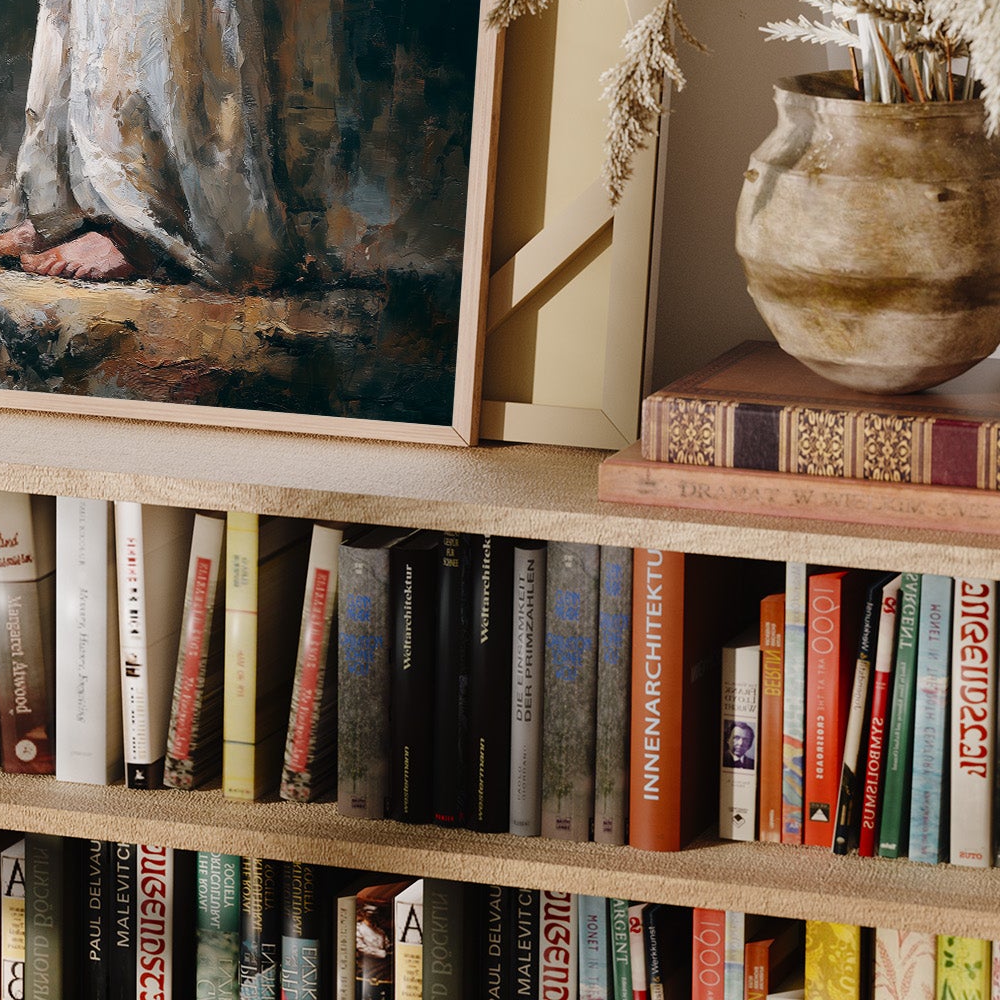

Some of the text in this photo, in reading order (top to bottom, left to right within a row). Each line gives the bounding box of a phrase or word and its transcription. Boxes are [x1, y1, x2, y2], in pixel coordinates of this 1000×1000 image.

[6, 595, 32, 714] Margaret Atwood
[402, 564, 413, 670] Weltarchitektur
[516, 575, 526, 722] DIE EINSAMKEIT
[524, 559, 536, 722] DER PRIMZAHLEN
[402, 746, 411, 813] westermann
[477, 738, 486, 820] westermann
[89, 840, 101, 961] PAUL DELVAU
[400, 903, 423, 945] A
[586, 914, 599, 951] MONET
[648, 926, 660, 975] Werkkunst
[695, 921, 722, 987] 1900
